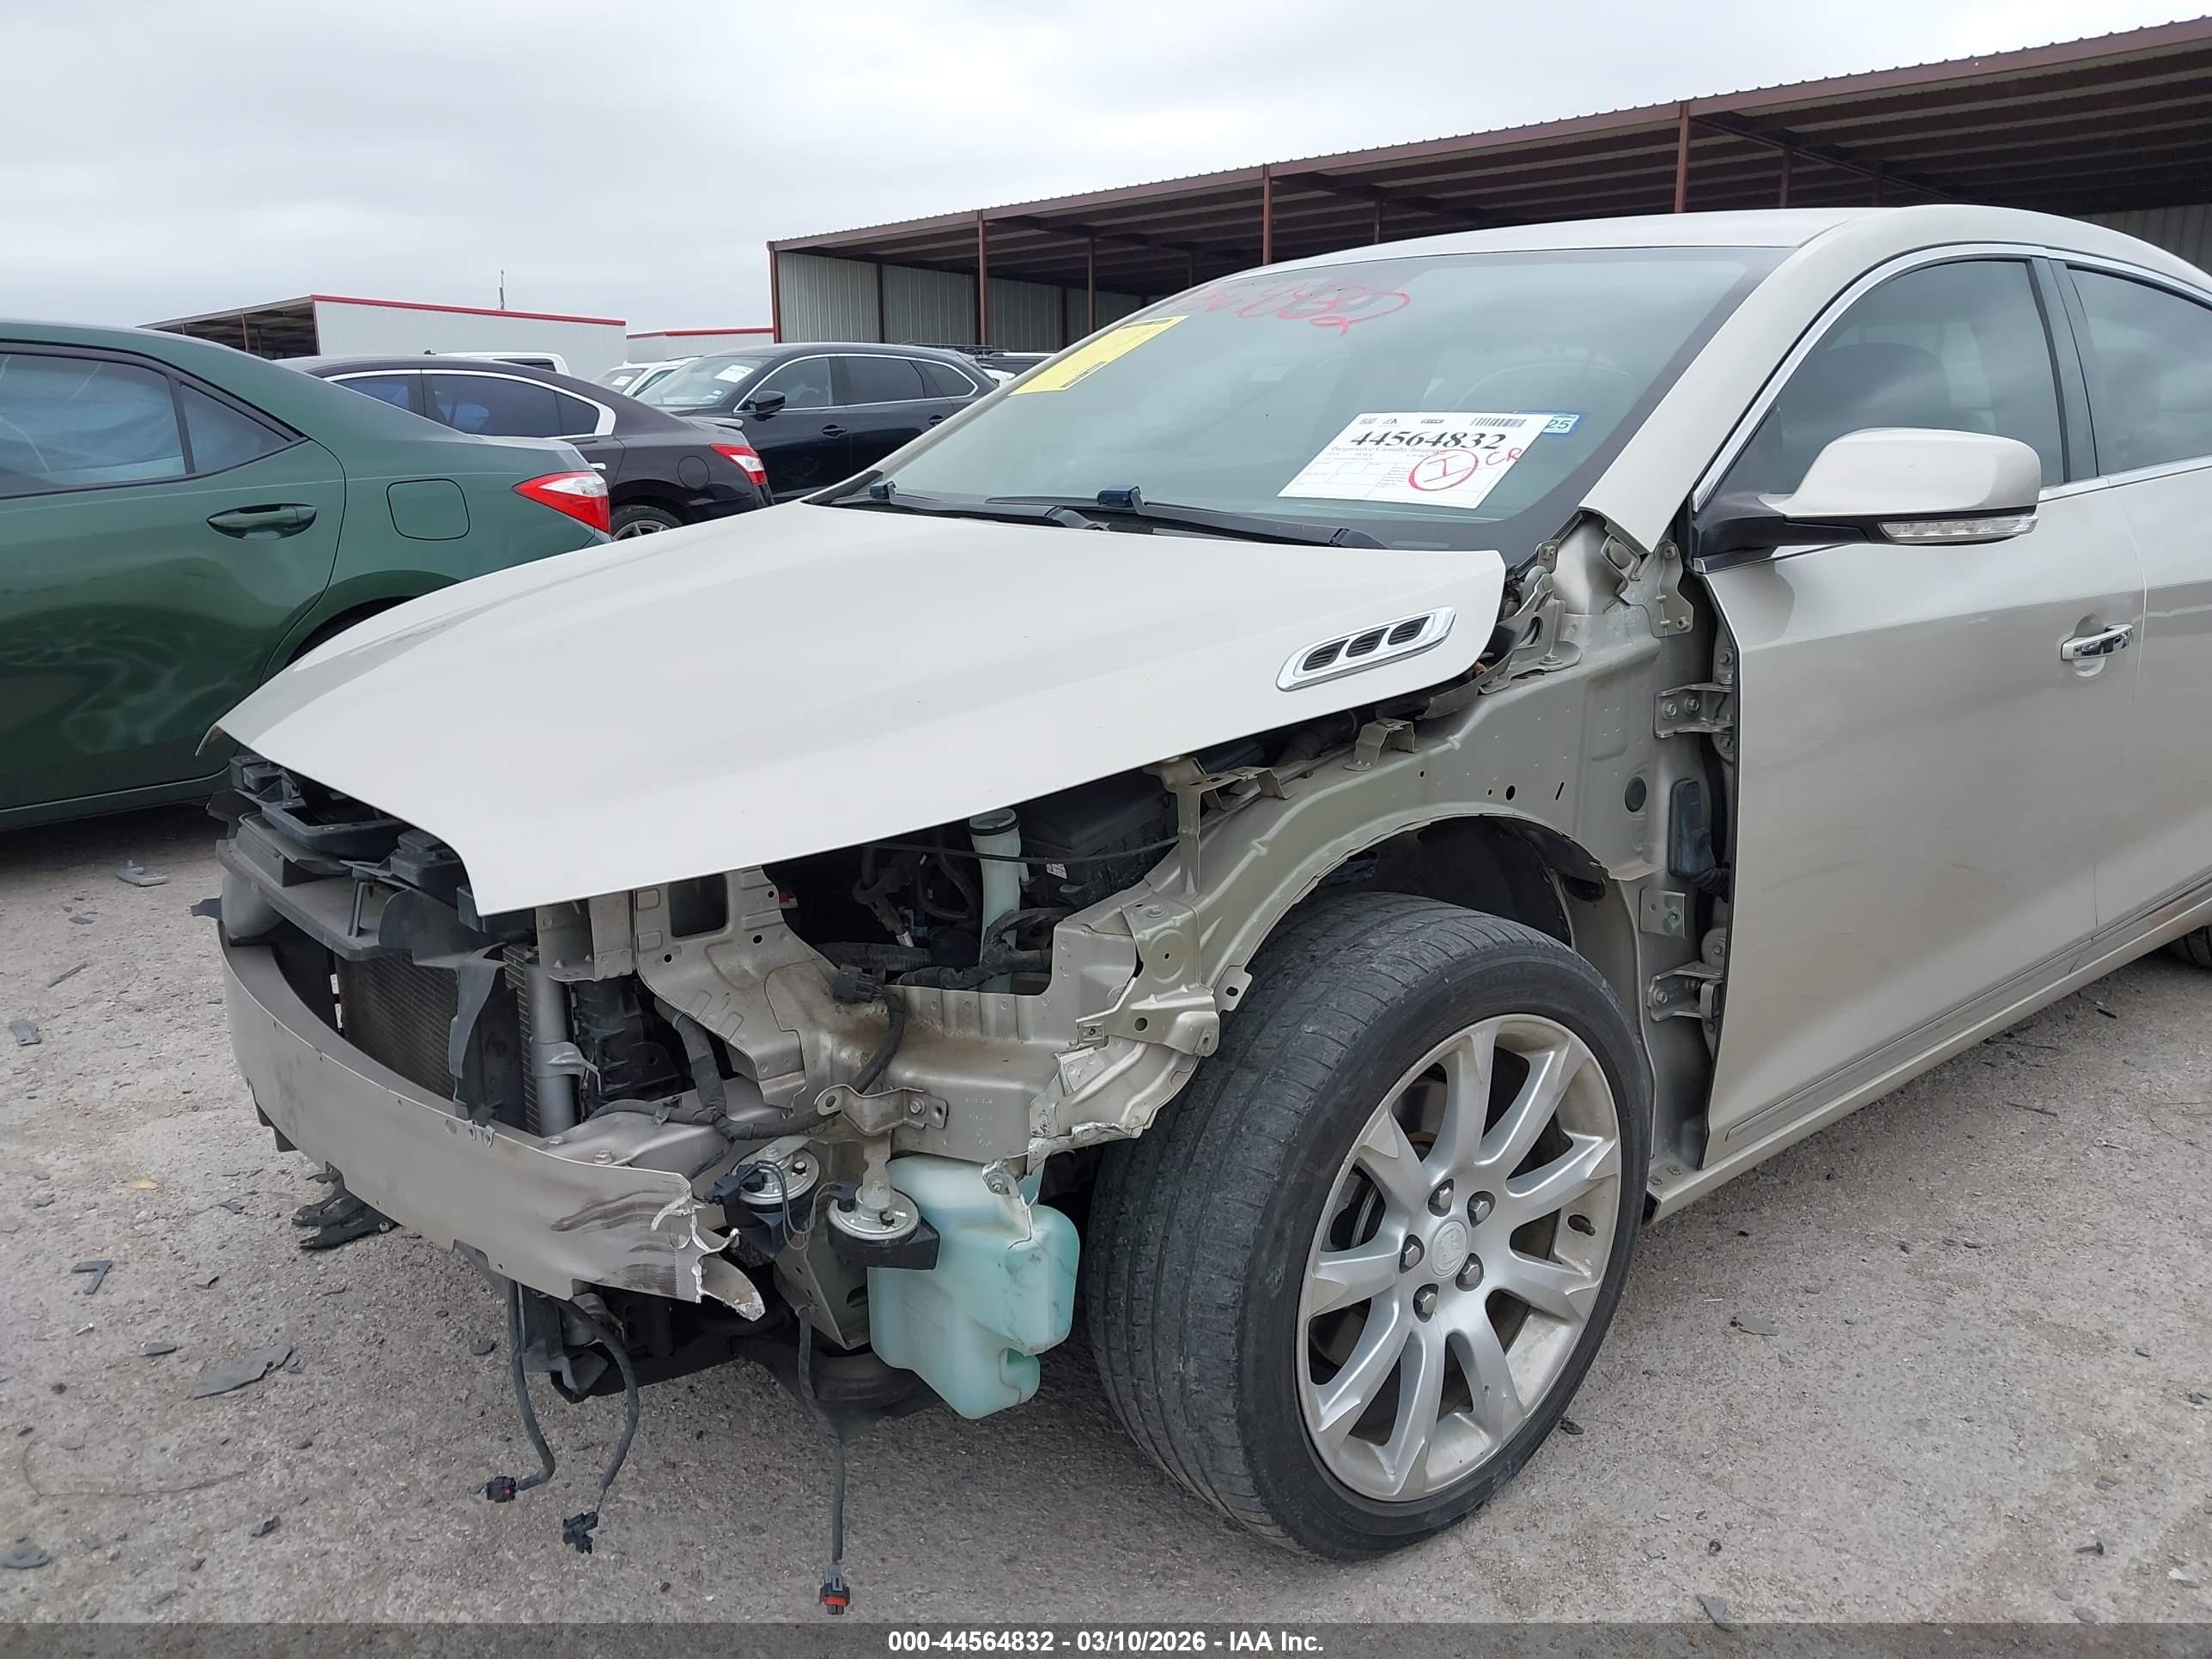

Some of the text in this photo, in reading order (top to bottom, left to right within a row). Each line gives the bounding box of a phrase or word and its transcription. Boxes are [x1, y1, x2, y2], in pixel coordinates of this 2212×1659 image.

[1546, 419, 1572, 429] 25
[1351, 431, 1506, 450] 44564832
[1486, 447, 1523, 466] CR
